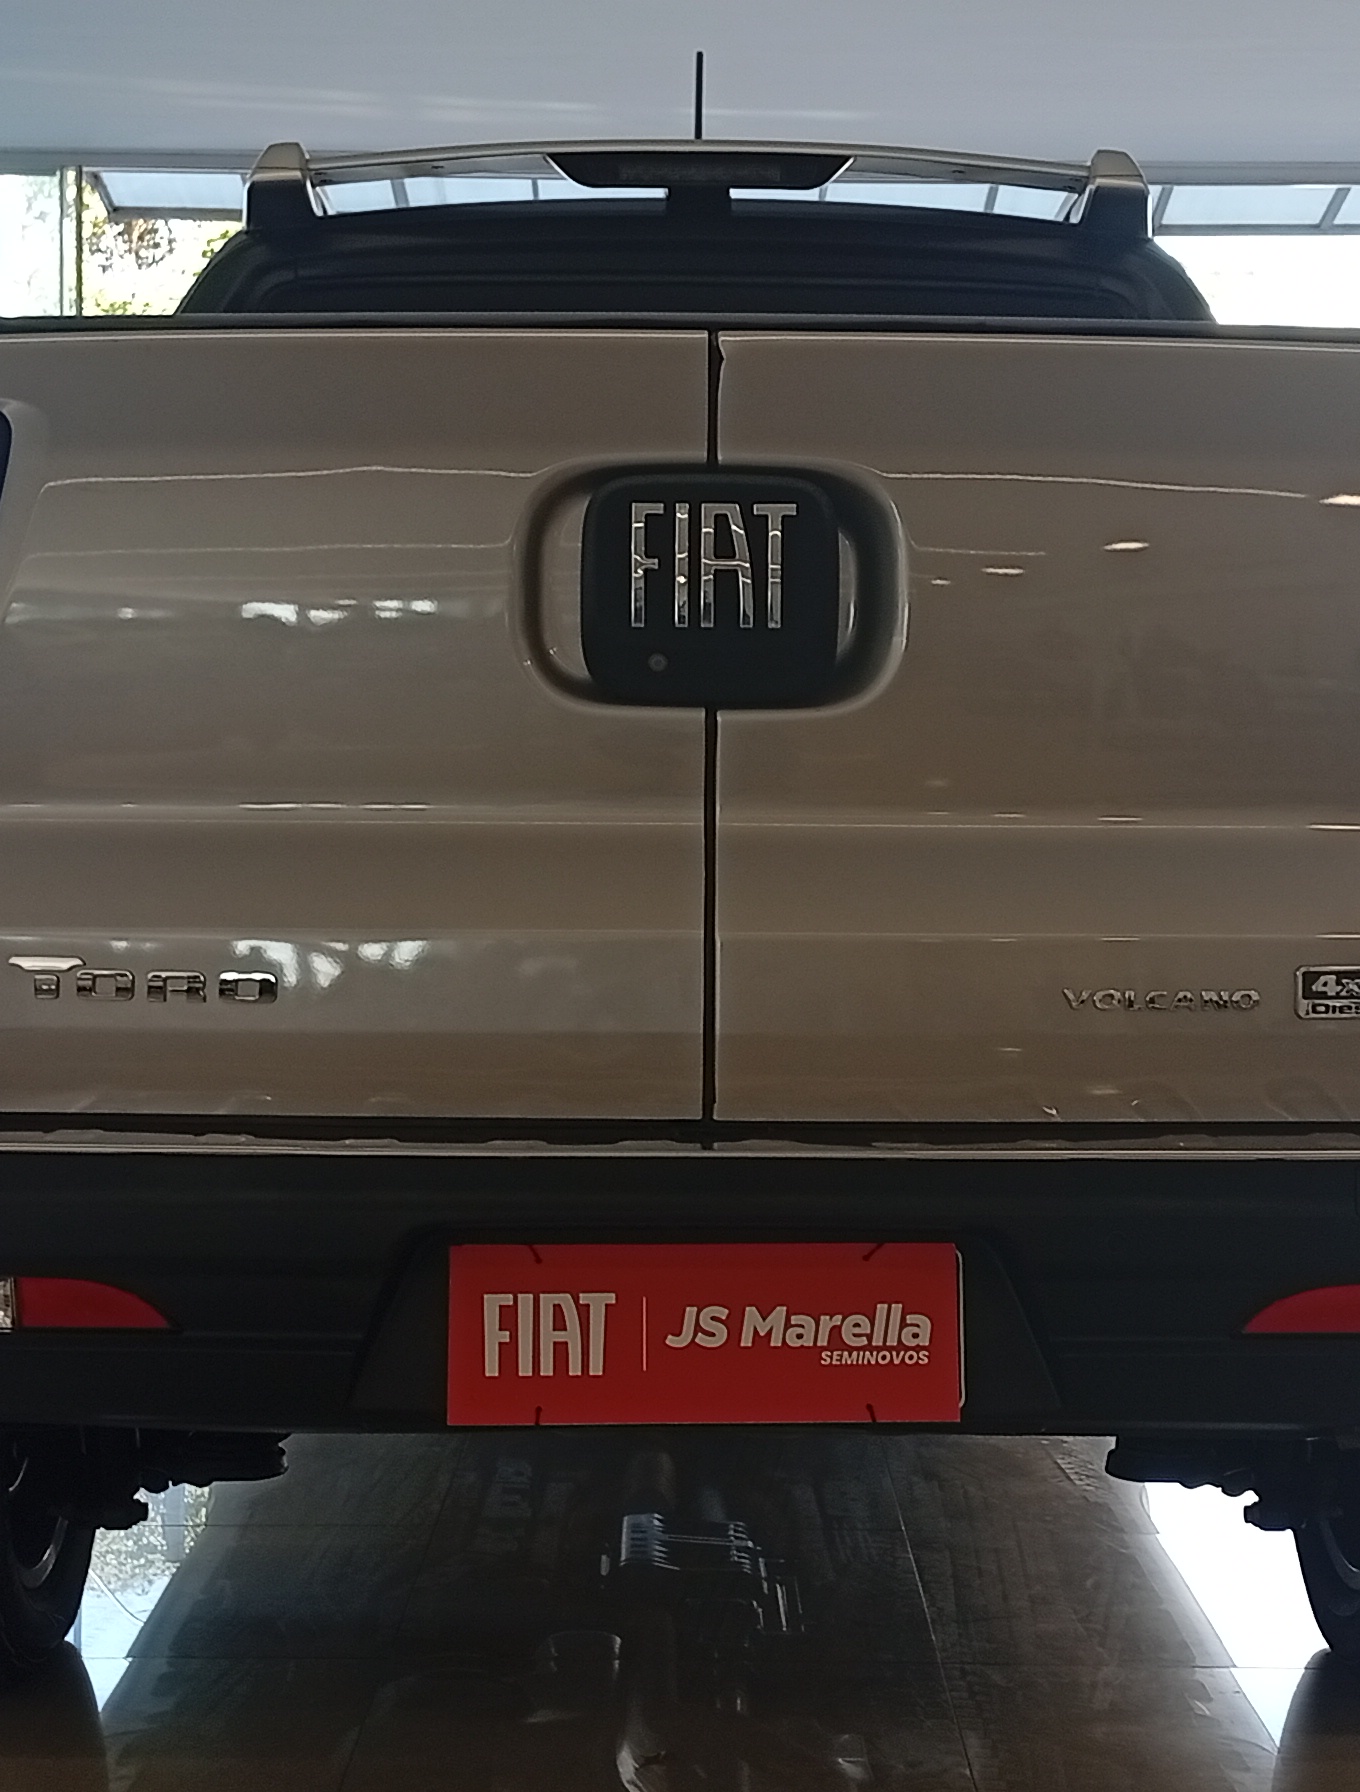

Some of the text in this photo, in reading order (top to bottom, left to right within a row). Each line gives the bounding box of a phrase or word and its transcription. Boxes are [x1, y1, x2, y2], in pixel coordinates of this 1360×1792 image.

[631, 502, 798, 628] FIAT
[8, 955, 279, 1003] TORO
[1062, 987, 1261, 1012] VOLCANO
[483, 1292, 933, 1378] FIAT JS Marella
[820, 1349, 931, 1366] SEMINOVOS
